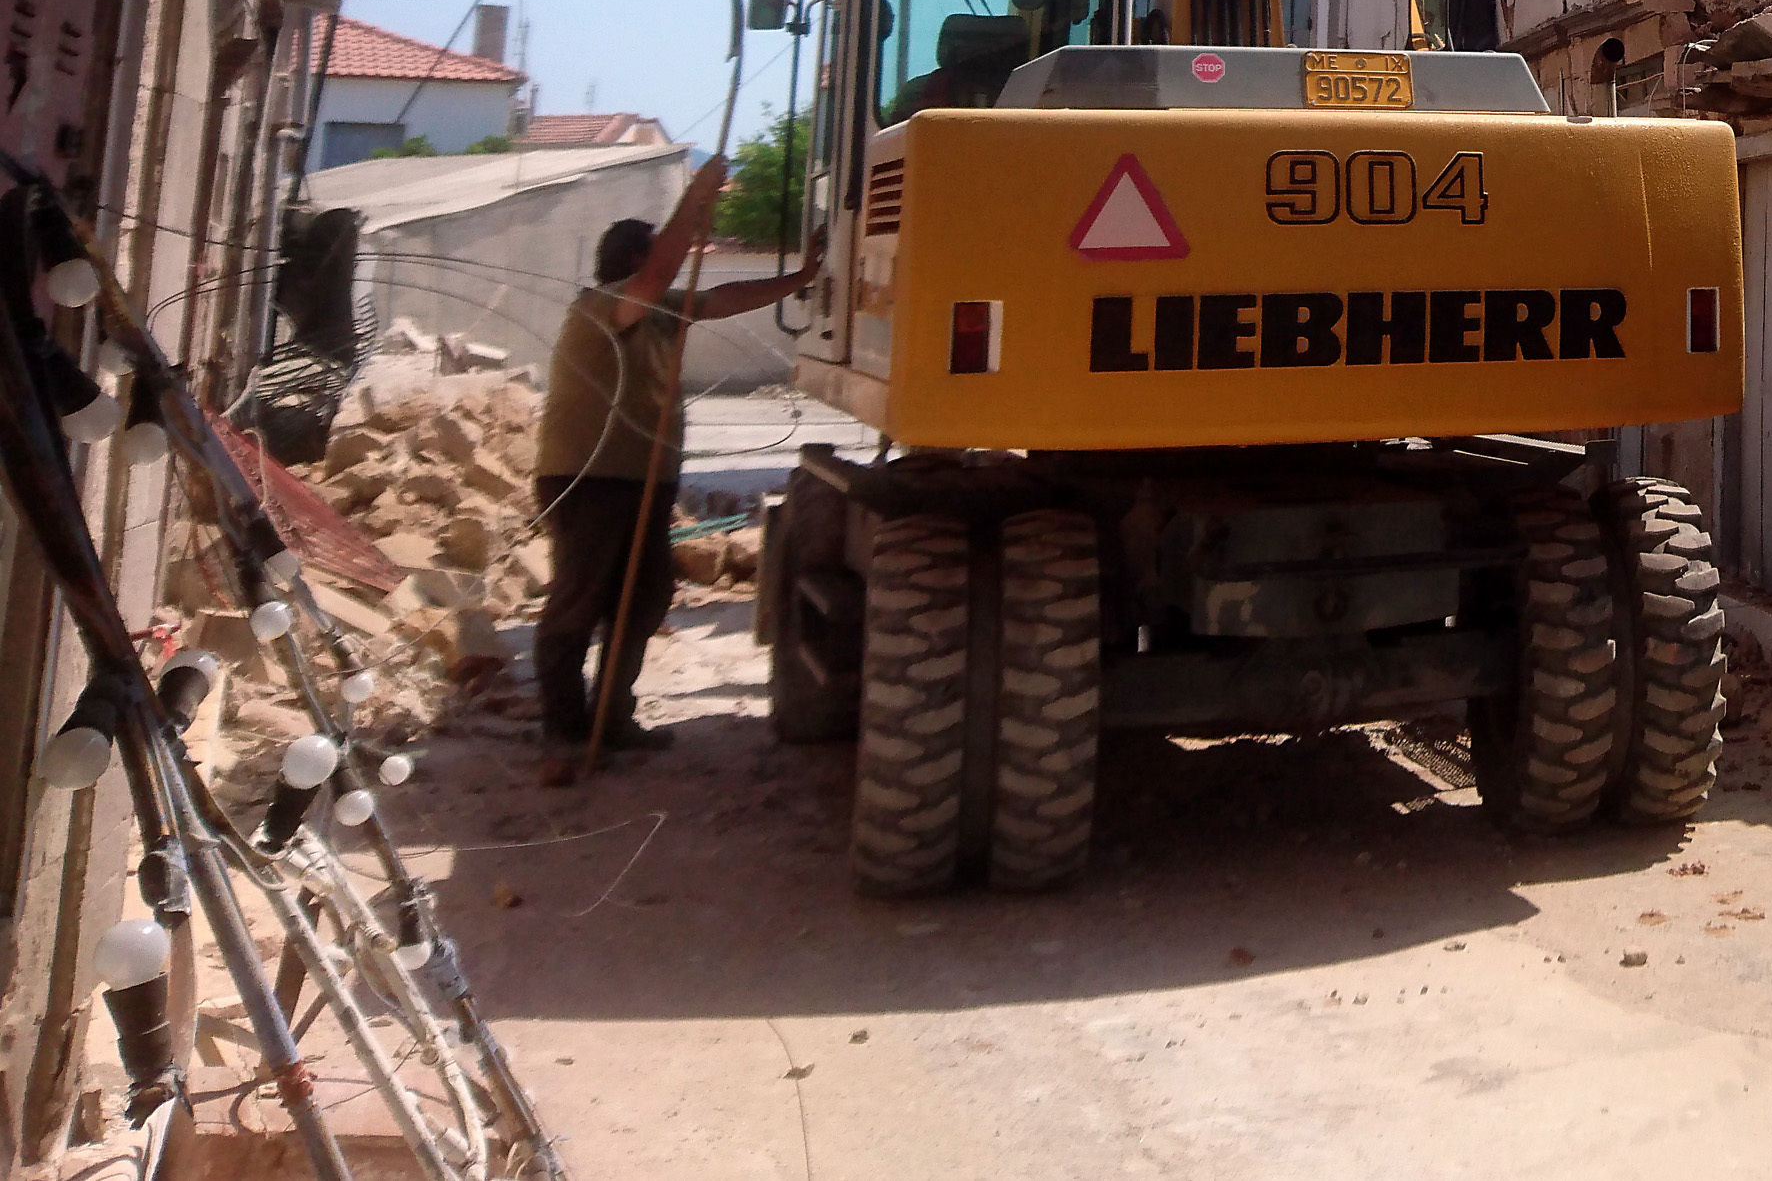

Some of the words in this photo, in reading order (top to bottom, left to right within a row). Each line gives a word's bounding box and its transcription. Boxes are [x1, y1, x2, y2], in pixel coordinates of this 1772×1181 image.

[1195, 63, 1222, 72] STOP
[1311, 53, 1339, 71] ME
[1384, 55, 1406, 72] IX
[1317, 74, 1403, 103] 90572
[1264, 149, 1490, 226] 904
[1089, 287, 1628, 373] LIEBHERR
